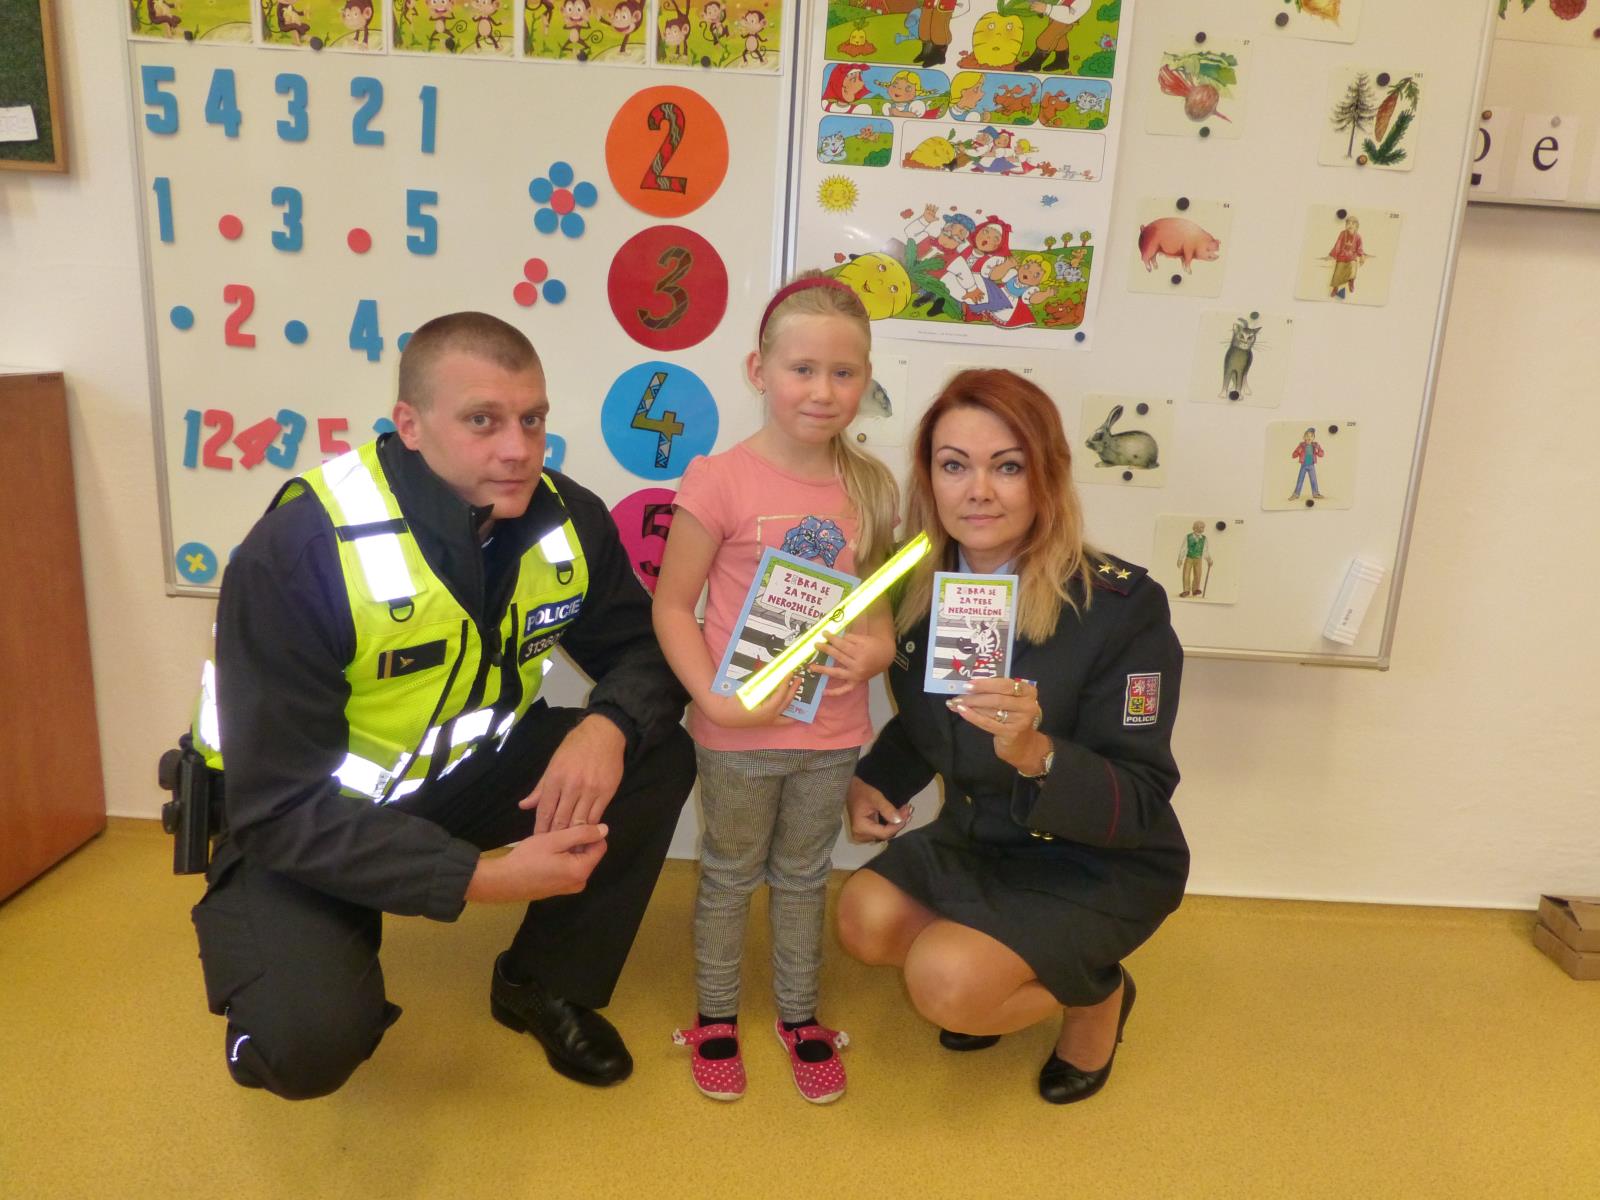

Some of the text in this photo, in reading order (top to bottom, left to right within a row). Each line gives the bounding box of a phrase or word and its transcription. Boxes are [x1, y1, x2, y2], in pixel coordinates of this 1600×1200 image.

[141, 65, 437, 154] 5 4 3 2 1
[640, 102, 688, 195] 2
[1532, 136, 1559, 171] e
[153, 177, 438, 255] 1 3 5
[636, 246, 693, 331] 3
[223, 284, 384, 361] 2 4
[630, 372, 685, 468] 4
[768, 594, 827, 619] NEROZHLÉDN
[784, 586, 823, 606] ZA TEBE
[820, 586, 831, 596] SE
[956, 587, 985, 596] ZBRA
[959, 597, 971, 605] ZA
[527, 598, 582, 631] POLICIE
